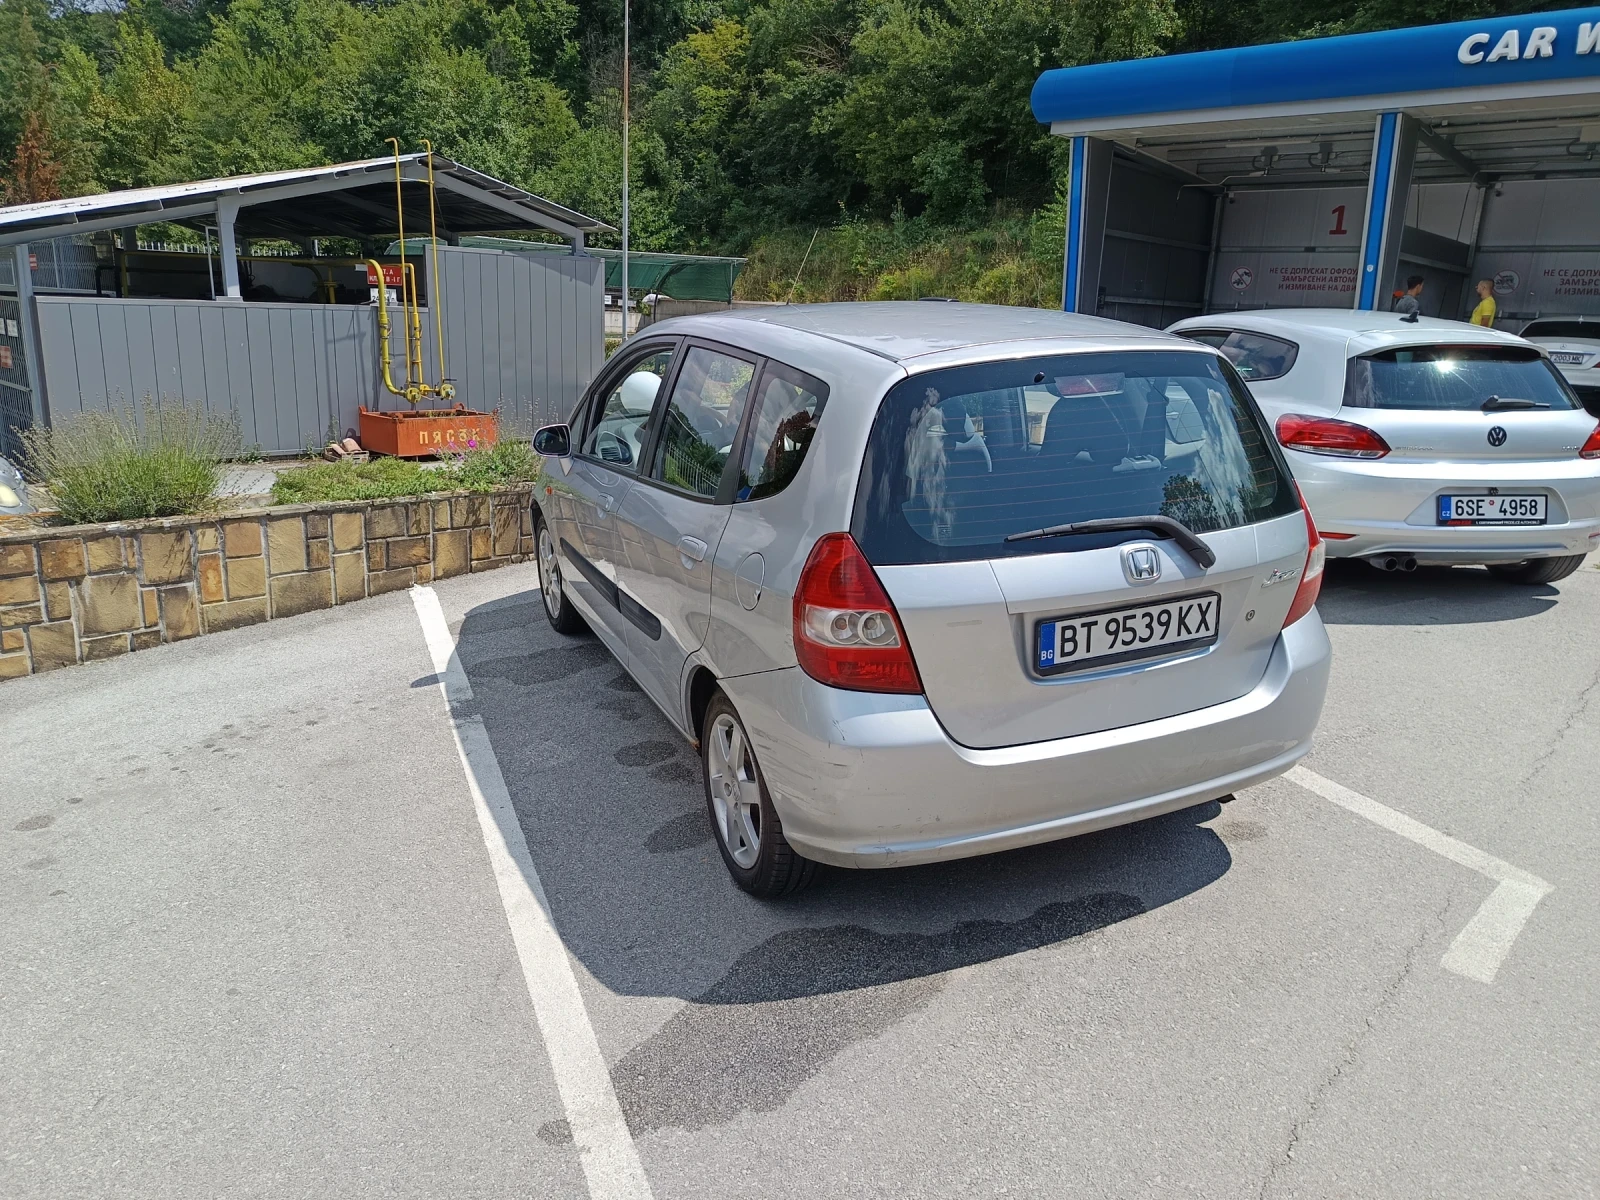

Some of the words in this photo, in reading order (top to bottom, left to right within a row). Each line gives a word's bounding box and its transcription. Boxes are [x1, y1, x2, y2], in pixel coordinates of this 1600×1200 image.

[1458, 27, 1557, 64] CAR
[1329, 204, 1348, 236] 1
[1280, 267, 1289, 275] СЕ
[1290, 267, 1328, 275] ДОПУСКАТ
[1330, 267, 1358, 275] ОФРОУ
[1543, 269, 1556, 277] НЕ
[1558, 269, 1569, 277] СЕ
[1571, 269, 1600, 278] ДОПУ
[1281, 275, 1327, 283] ЗАМЪРСЕНИ
[1328, 275, 1357, 283] АВТОМ
[1285, 283, 1326, 291] ИЗМИВАНЕ
[1555, 287, 1562, 295] И
[1554, 354, 1571, 362] 2003
[419, 428, 481, 444] ПЯСЪК
[1455, 499, 1485, 516] 6SE
[1499, 499, 1538, 516] 4958
[1060, 620, 1099, 658] BT
[1104, 609, 1172, 650] 9539
[1176, 601, 1212, 637] KX
[1040, 650, 1054, 661] BG
